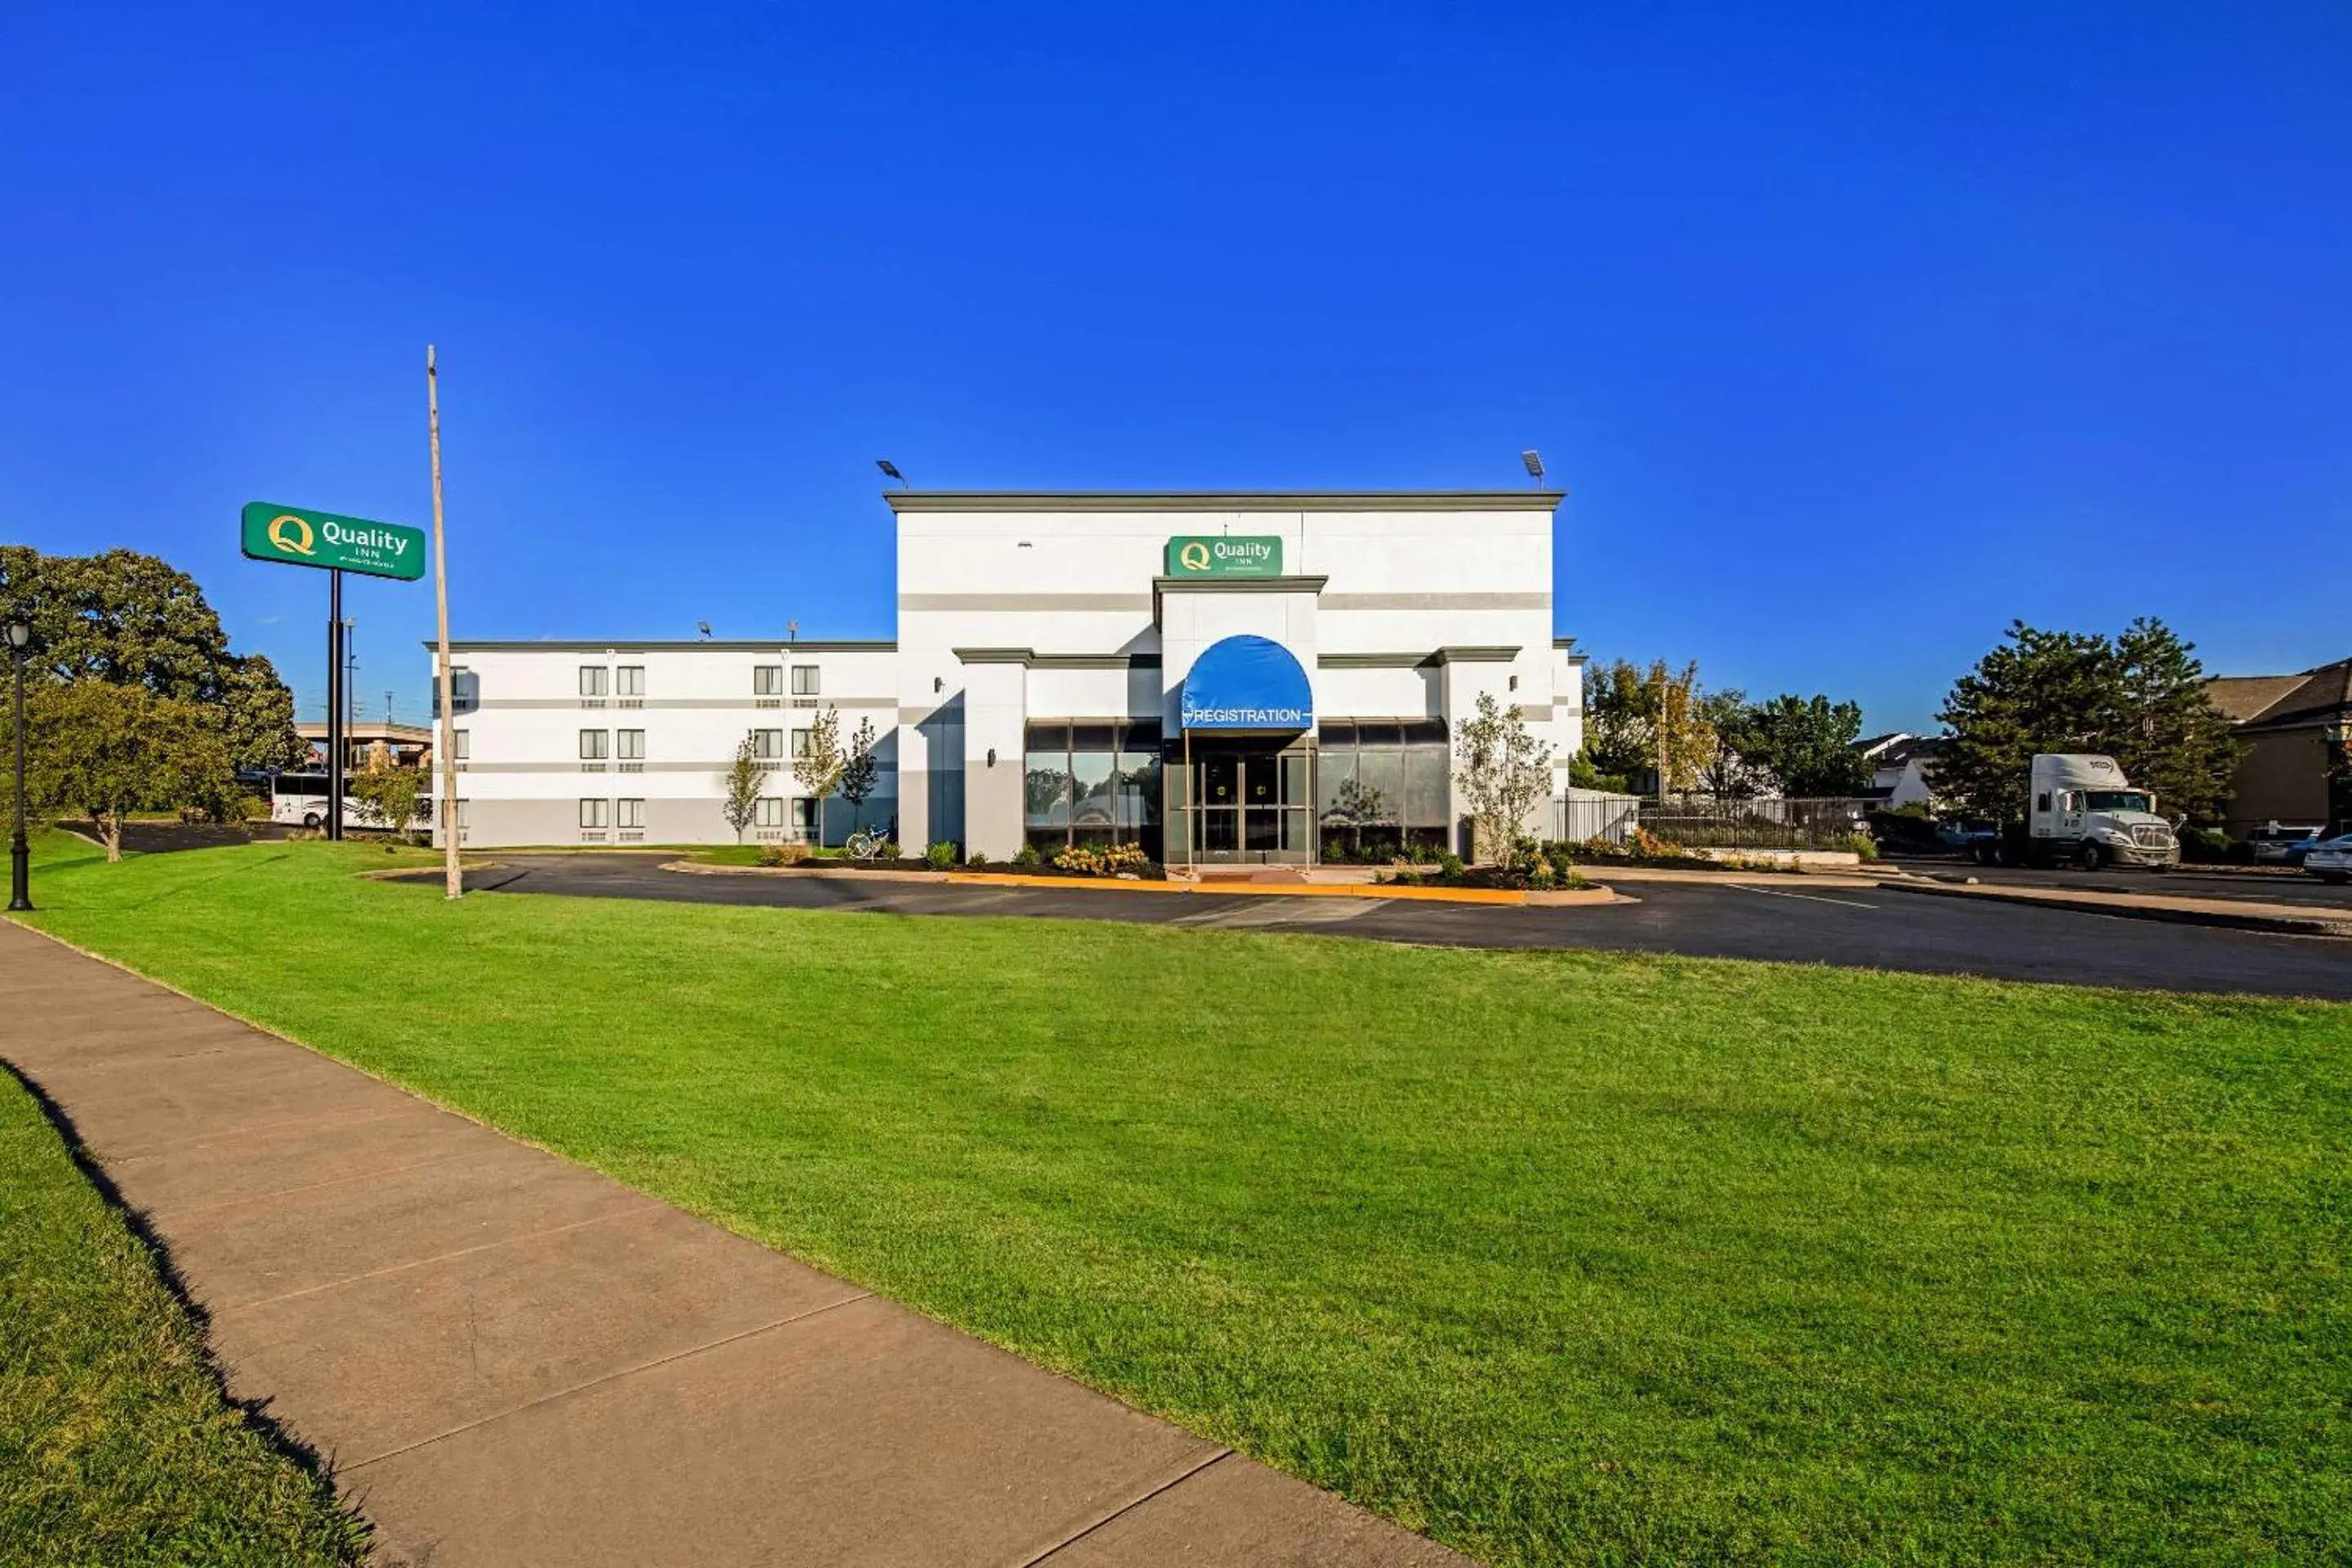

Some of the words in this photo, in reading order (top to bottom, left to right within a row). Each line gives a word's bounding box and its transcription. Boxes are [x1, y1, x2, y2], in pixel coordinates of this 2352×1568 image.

[268, 515, 317, 556] Q
[323, 522, 408, 555] Quality
[355, 547, 380, 559] INN
[1181, 541, 1211, 570] Q
[1214, 542, 1272, 560] Quality
[1194, 710, 1301, 722] REGISTRATION
